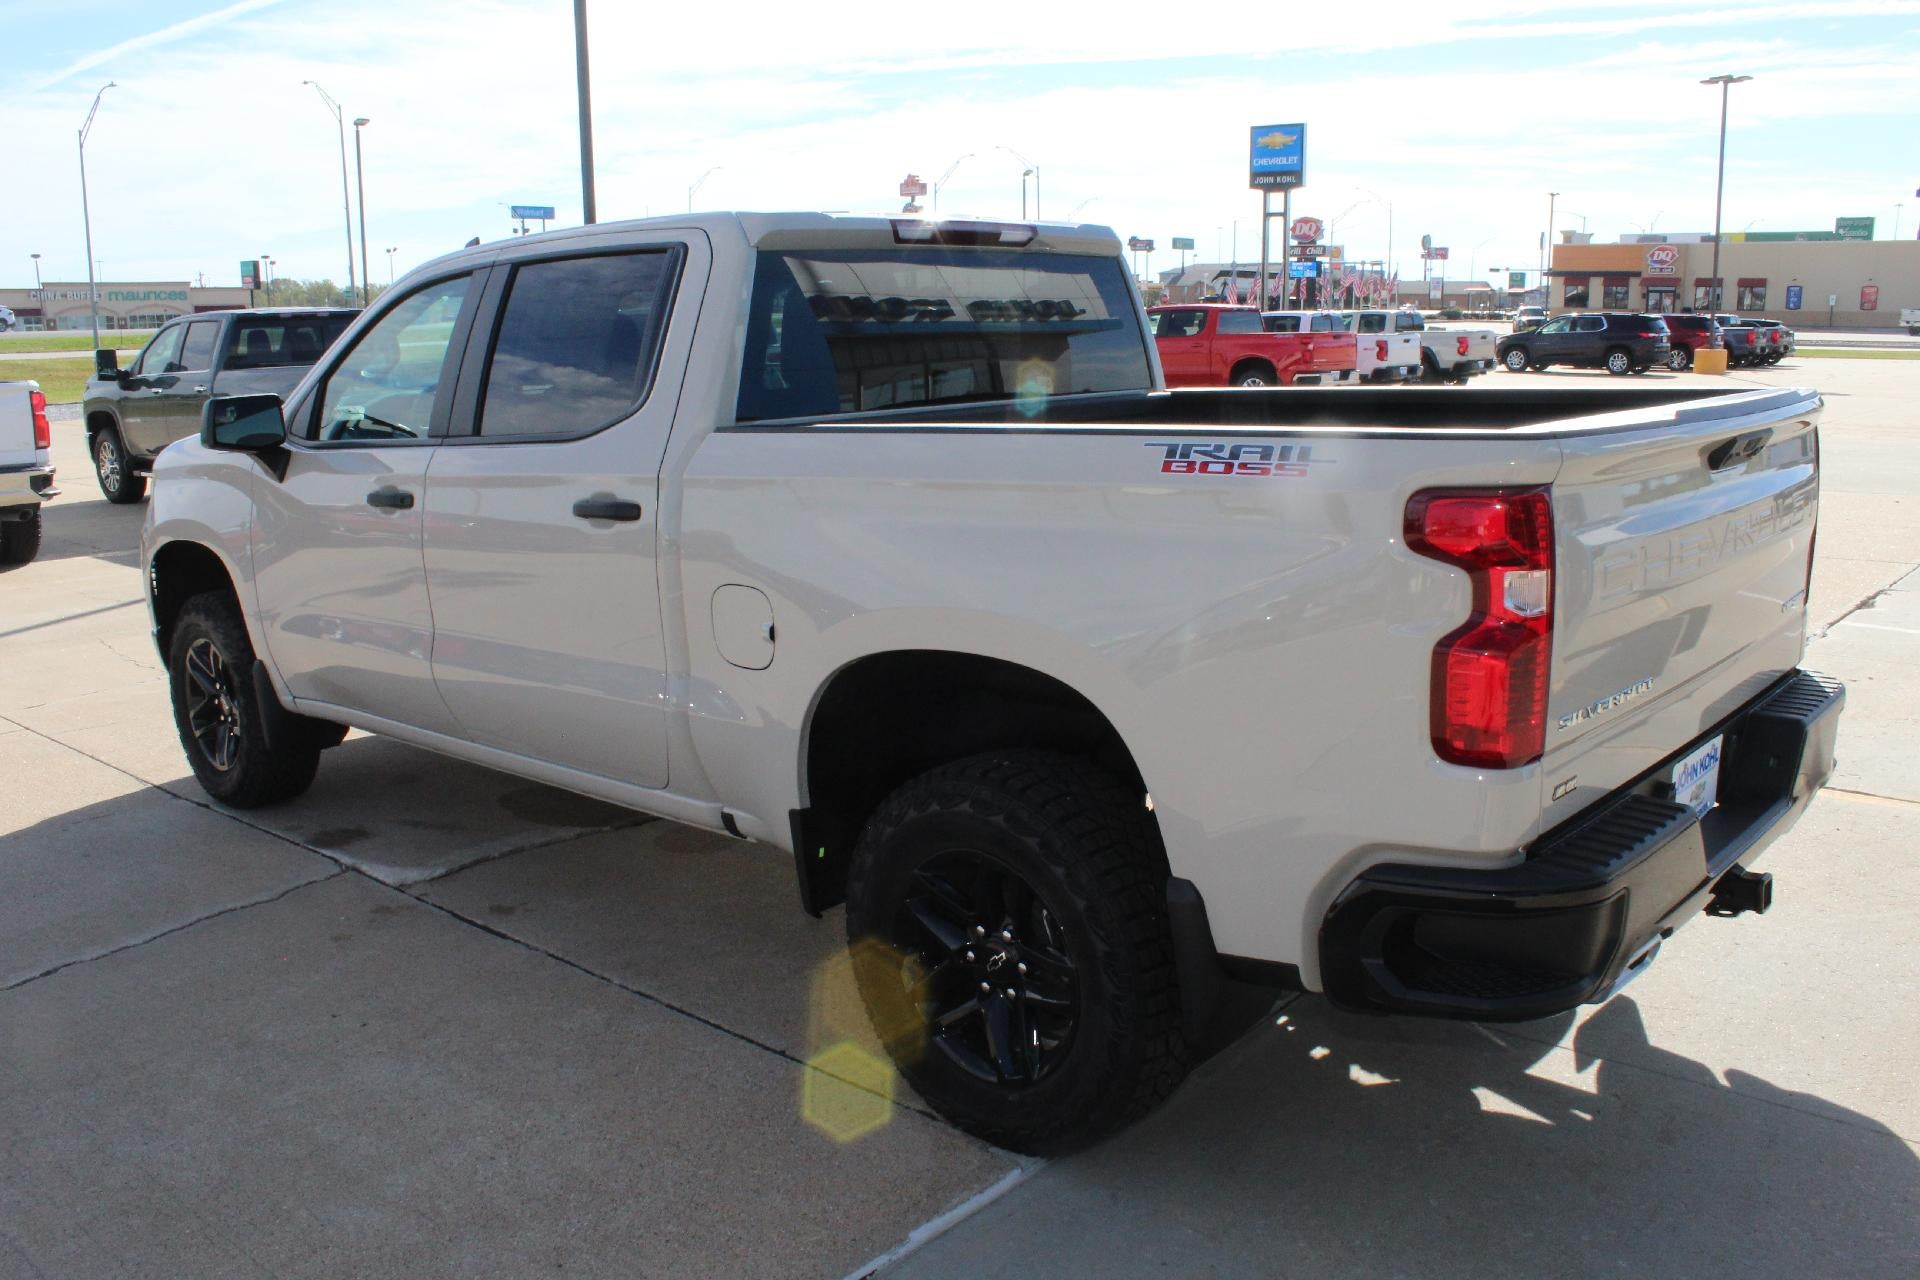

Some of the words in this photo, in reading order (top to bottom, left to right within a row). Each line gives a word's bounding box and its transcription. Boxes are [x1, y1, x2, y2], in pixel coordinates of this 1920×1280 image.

[1254, 156, 1298, 166] CHEVROLET
[1295, 223, 1316, 237] DQ
[1653, 250, 1673, 261] DQ
[1144, 442, 1336, 463] TRAIL
[1161, 459, 1309, 477] BOSS
